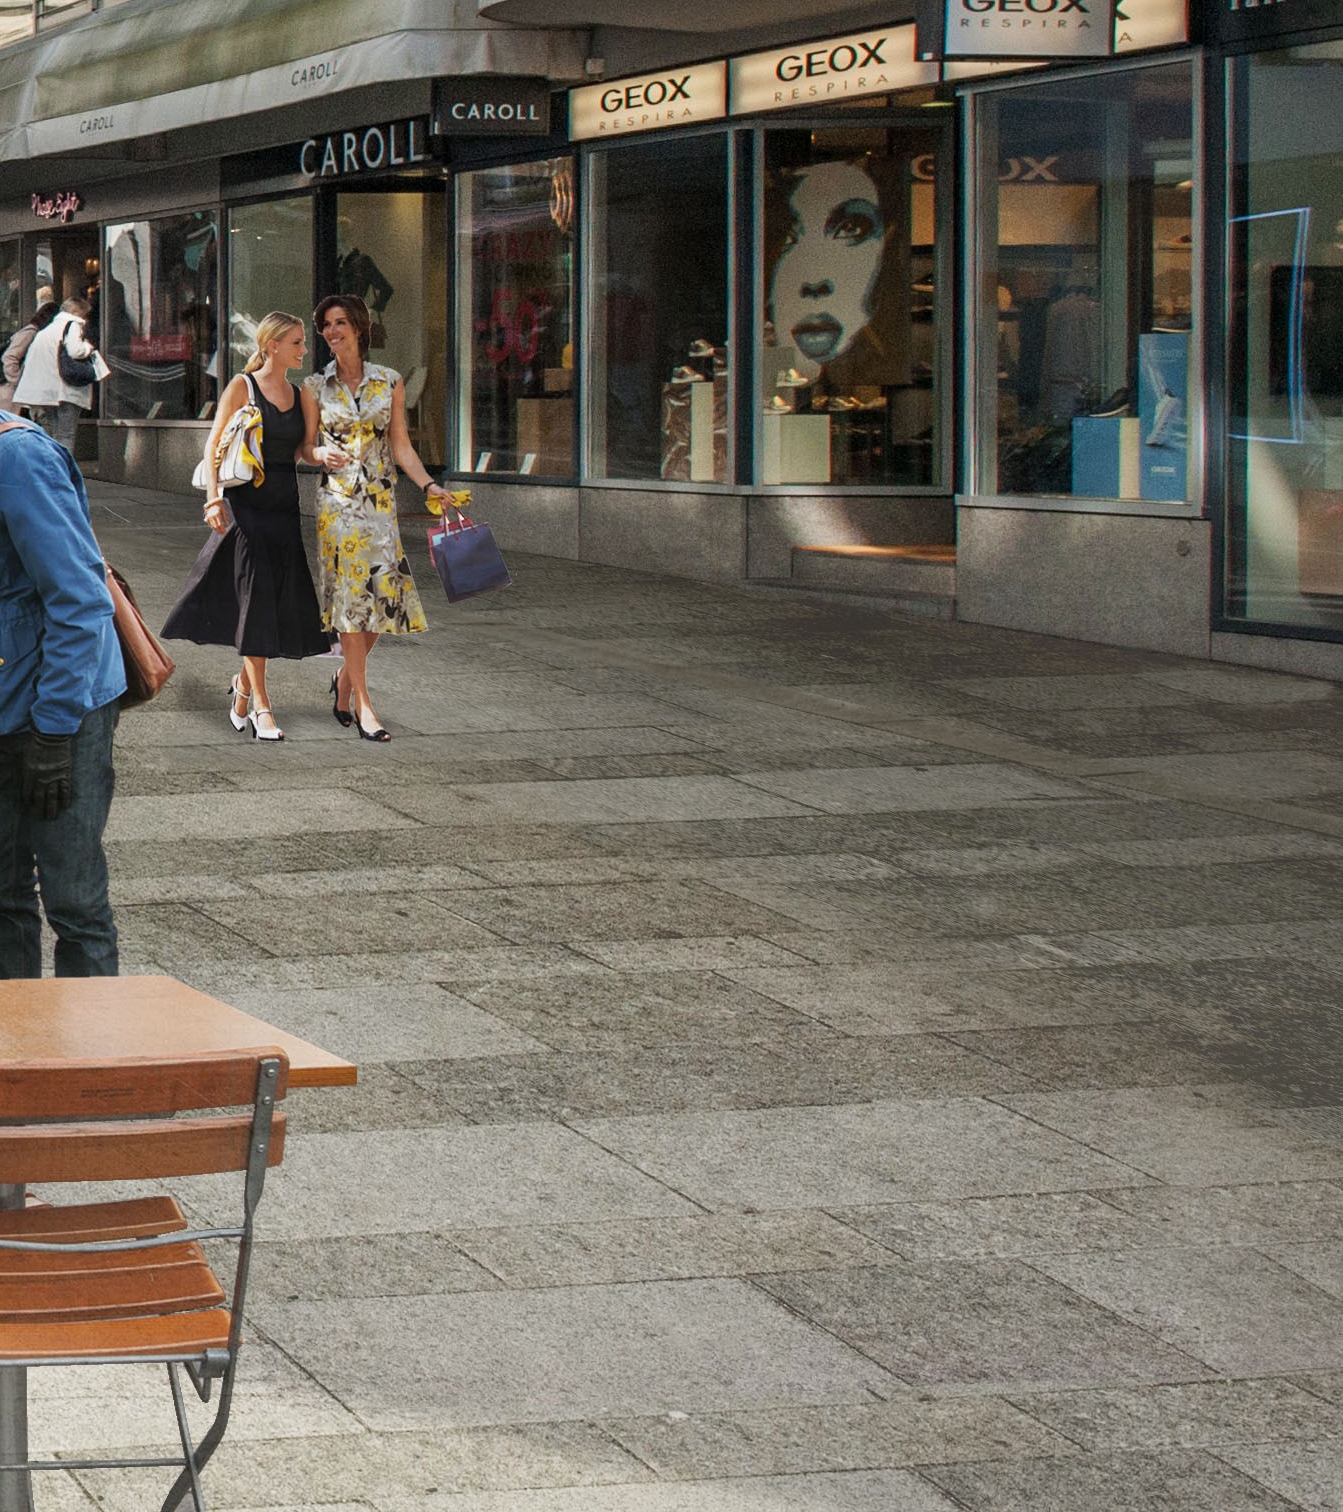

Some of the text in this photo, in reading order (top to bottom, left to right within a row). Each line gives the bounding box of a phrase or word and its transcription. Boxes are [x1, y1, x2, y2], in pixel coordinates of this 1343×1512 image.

[960, 18, 1091, 29] RESPIRA
[291, 60, 338, 86] CAROLL
[775, 38, 888, 82] GEOX
[600, 75, 692, 113] GEOX
[774, 74, 889, 103] RESPIRA
[80, 115, 114, 134] CAROLL
[451, 103, 540, 120] CAROLL
[599, 108, 693, 131] RESPIRA
[300, 120, 425, 178] CAROLL
